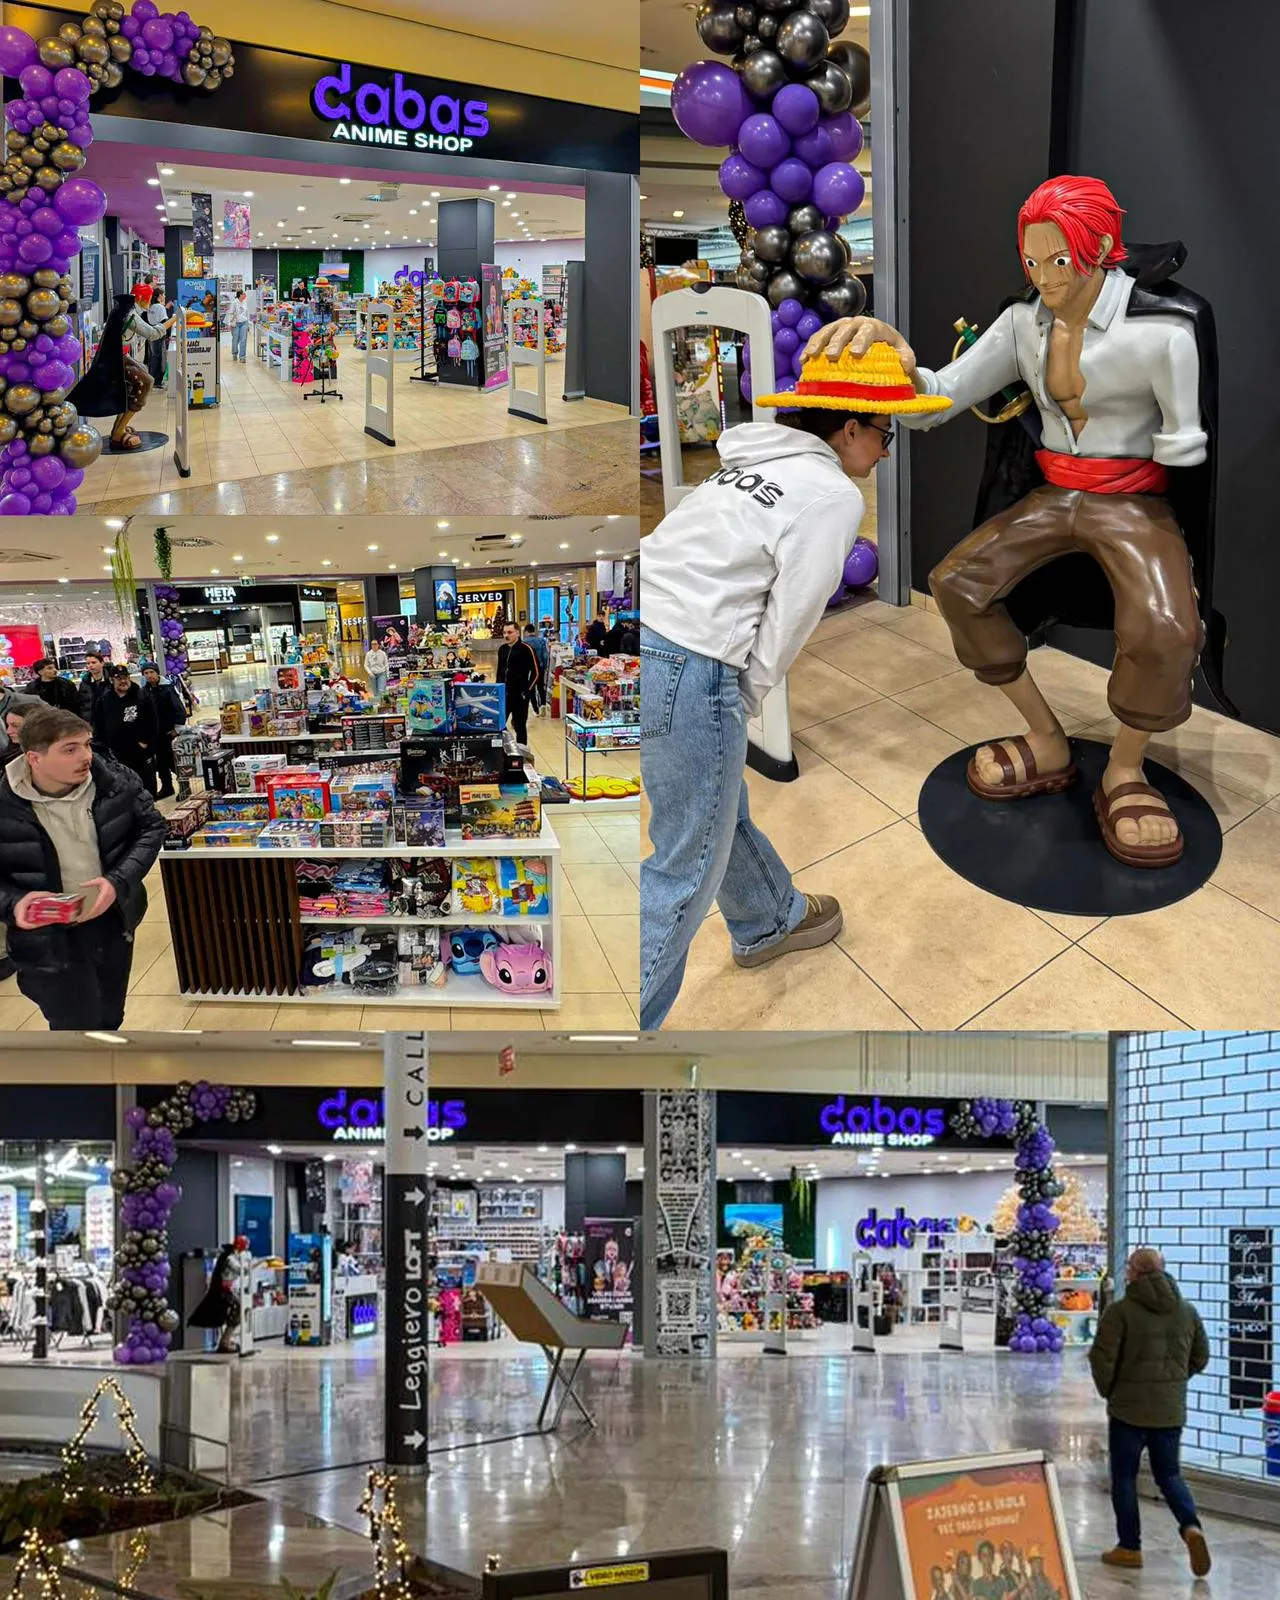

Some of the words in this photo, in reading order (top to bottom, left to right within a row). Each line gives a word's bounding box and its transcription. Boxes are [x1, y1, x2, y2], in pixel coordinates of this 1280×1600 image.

[312, 63, 491, 137] dabas
[332, 123, 408, 146] ANIME
[414, 132, 473, 152] SHOP
[204, 587, 237, 598] HETA
[457, 592, 503, 603] SERVED
[820, 1096, 945, 1135] dabas
[831, 1132, 884, 1145] ANIME
[887, 1133, 935, 1146] SHOP
[404, 1228, 422, 1281] LOFT
[399, 1287, 427, 1411] Leggiero
